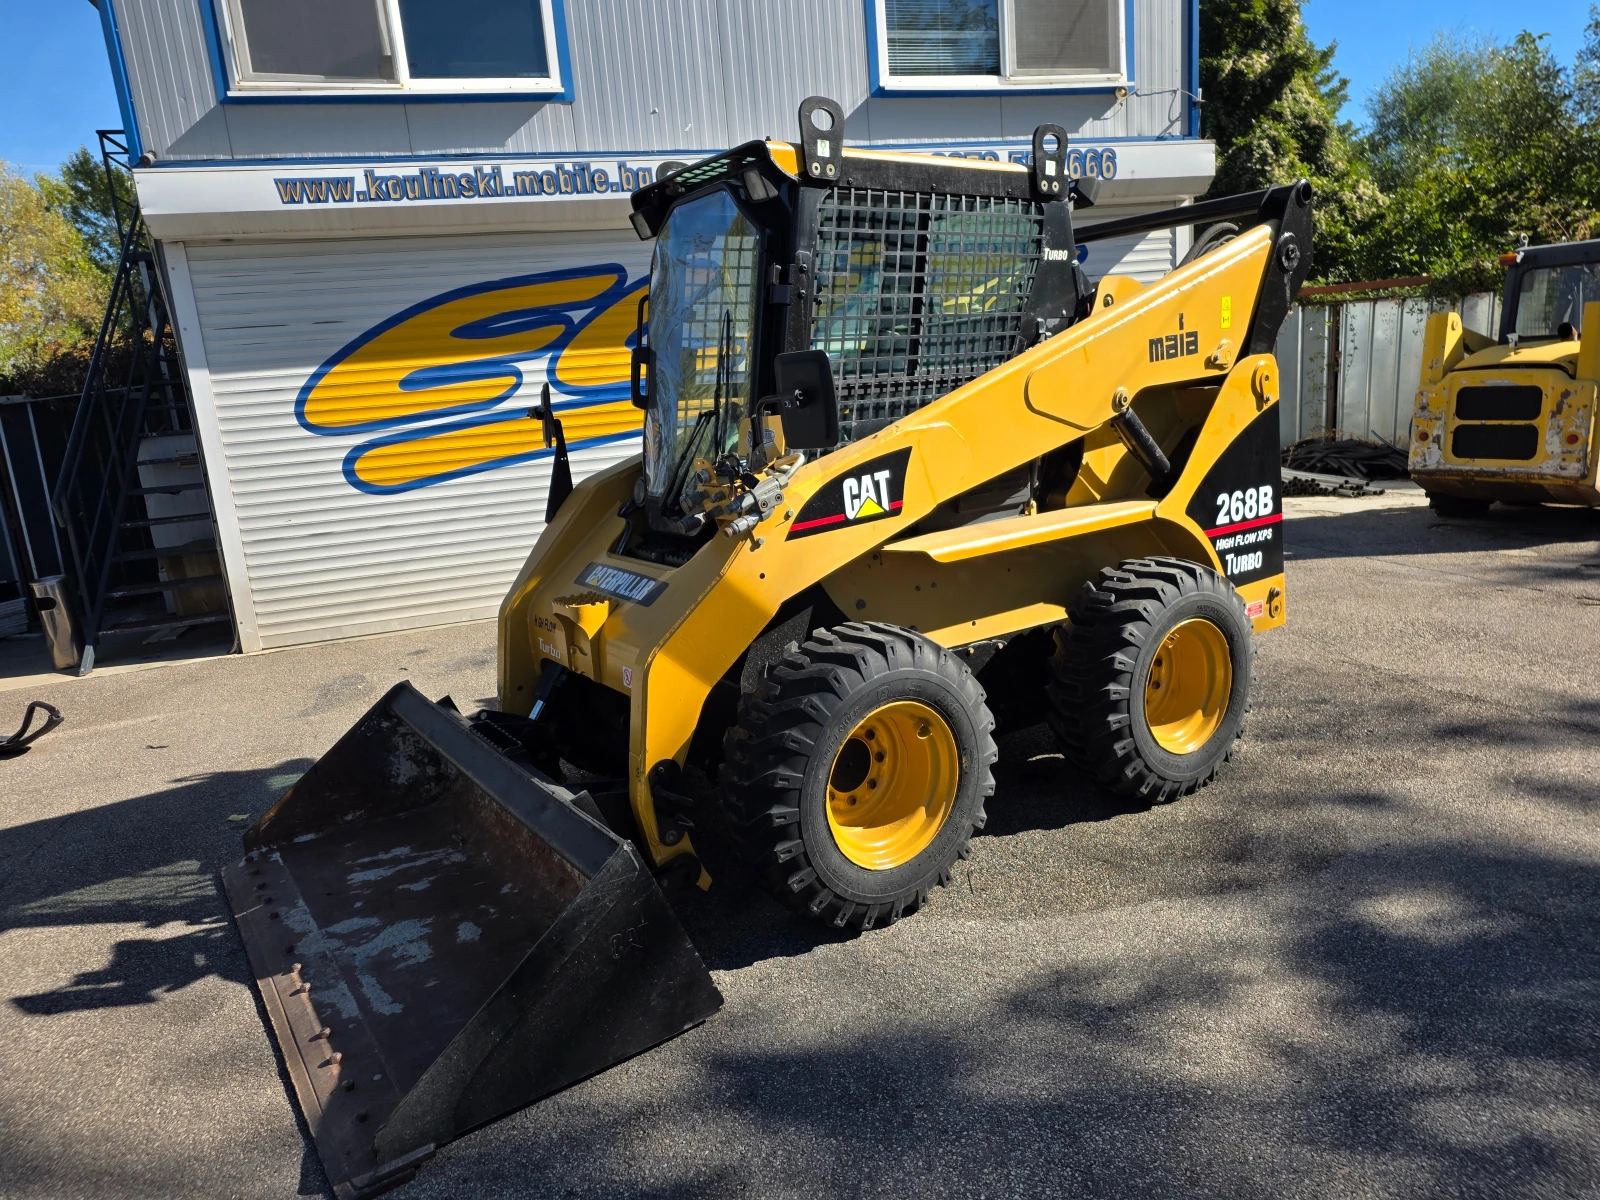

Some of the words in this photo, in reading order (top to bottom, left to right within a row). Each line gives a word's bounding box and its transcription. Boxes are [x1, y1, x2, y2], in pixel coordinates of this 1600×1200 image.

[1067, 148, 1117, 181] 666
[1044, 247, 1068, 261] TURBO
[842, 469, 890, 520] CAT
[1215, 485, 1273, 525] 268B
[1215, 536, 1235, 551] HIGH
[1234, 532, 1257, 547] FLOW
[1256, 527, 1273, 542] XPS
[1225, 550, 1263, 576] TURBO
[584, 564, 656, 601] CATERPILLAR
[537, 636, 561, 660] Turbo
